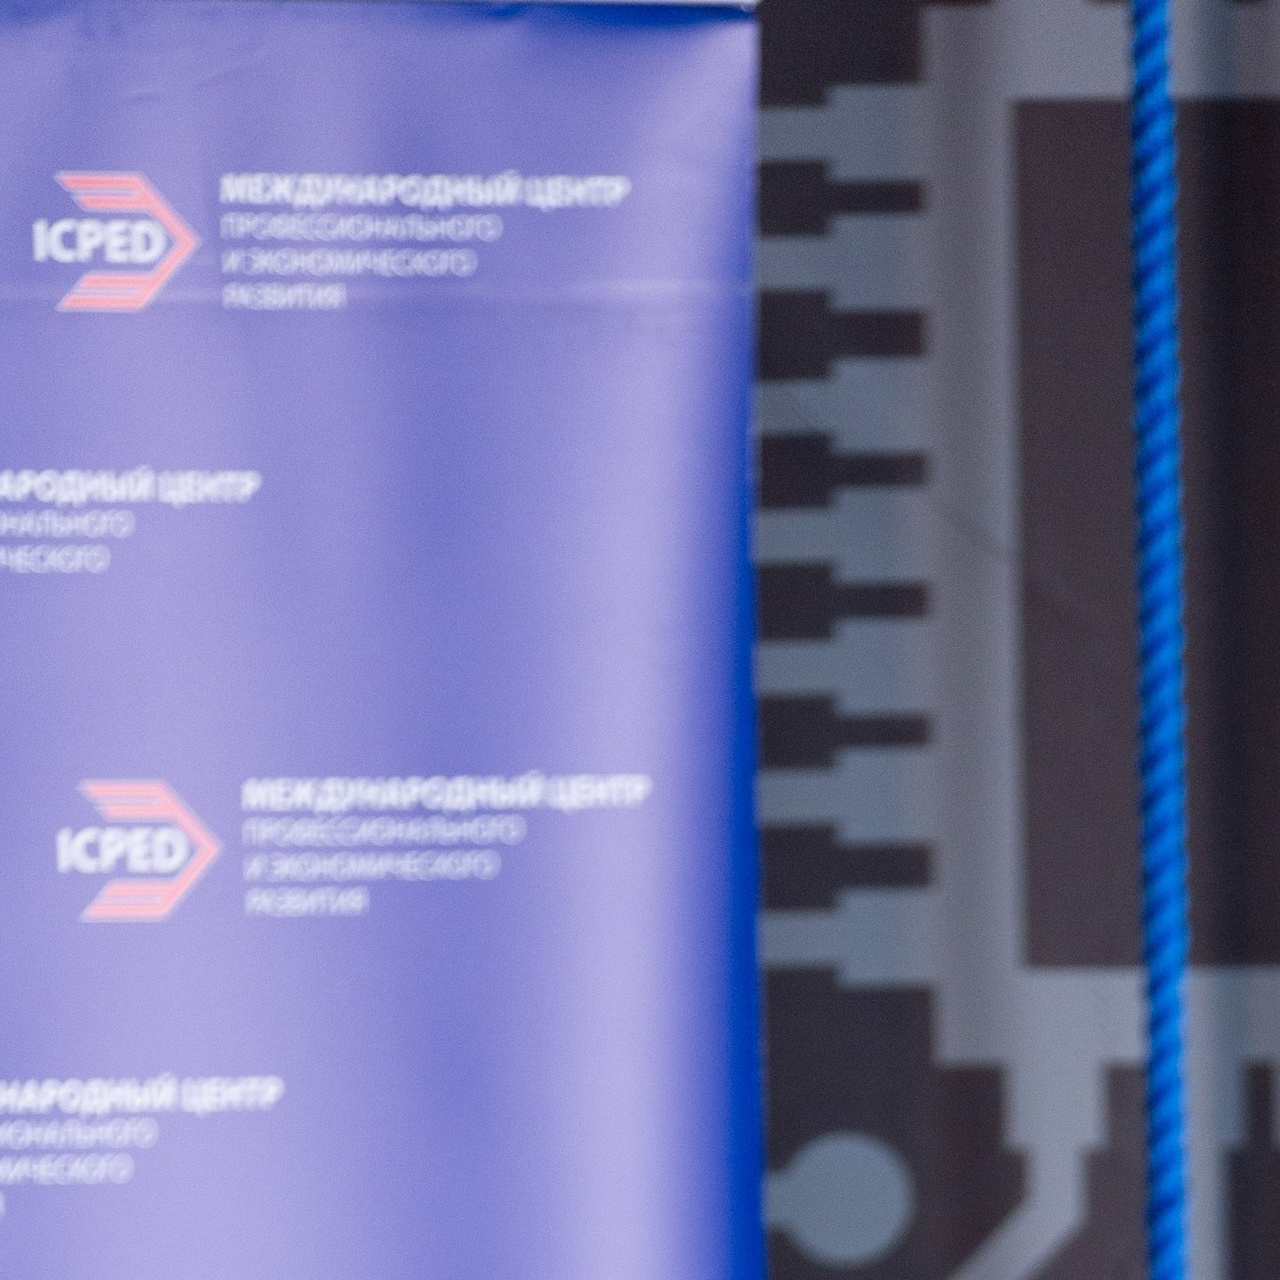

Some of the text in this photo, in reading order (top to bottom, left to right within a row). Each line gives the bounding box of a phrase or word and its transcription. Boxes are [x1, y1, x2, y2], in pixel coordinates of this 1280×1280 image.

[220, 171, 629, 210] МЕЖДУНАРОДНЫЙ ЦЕНТР
[33, 219, 166, 262] ICPED
[157, 470, 260, 506] ЦЕНТР
[242, 770, 650, 812] МЕЖДУНАРОДНЫЙ ЦЕНТР
[56, 827, 190, 873] ICPED
[181, 1076, 284, 1116] ЦЕНТР
